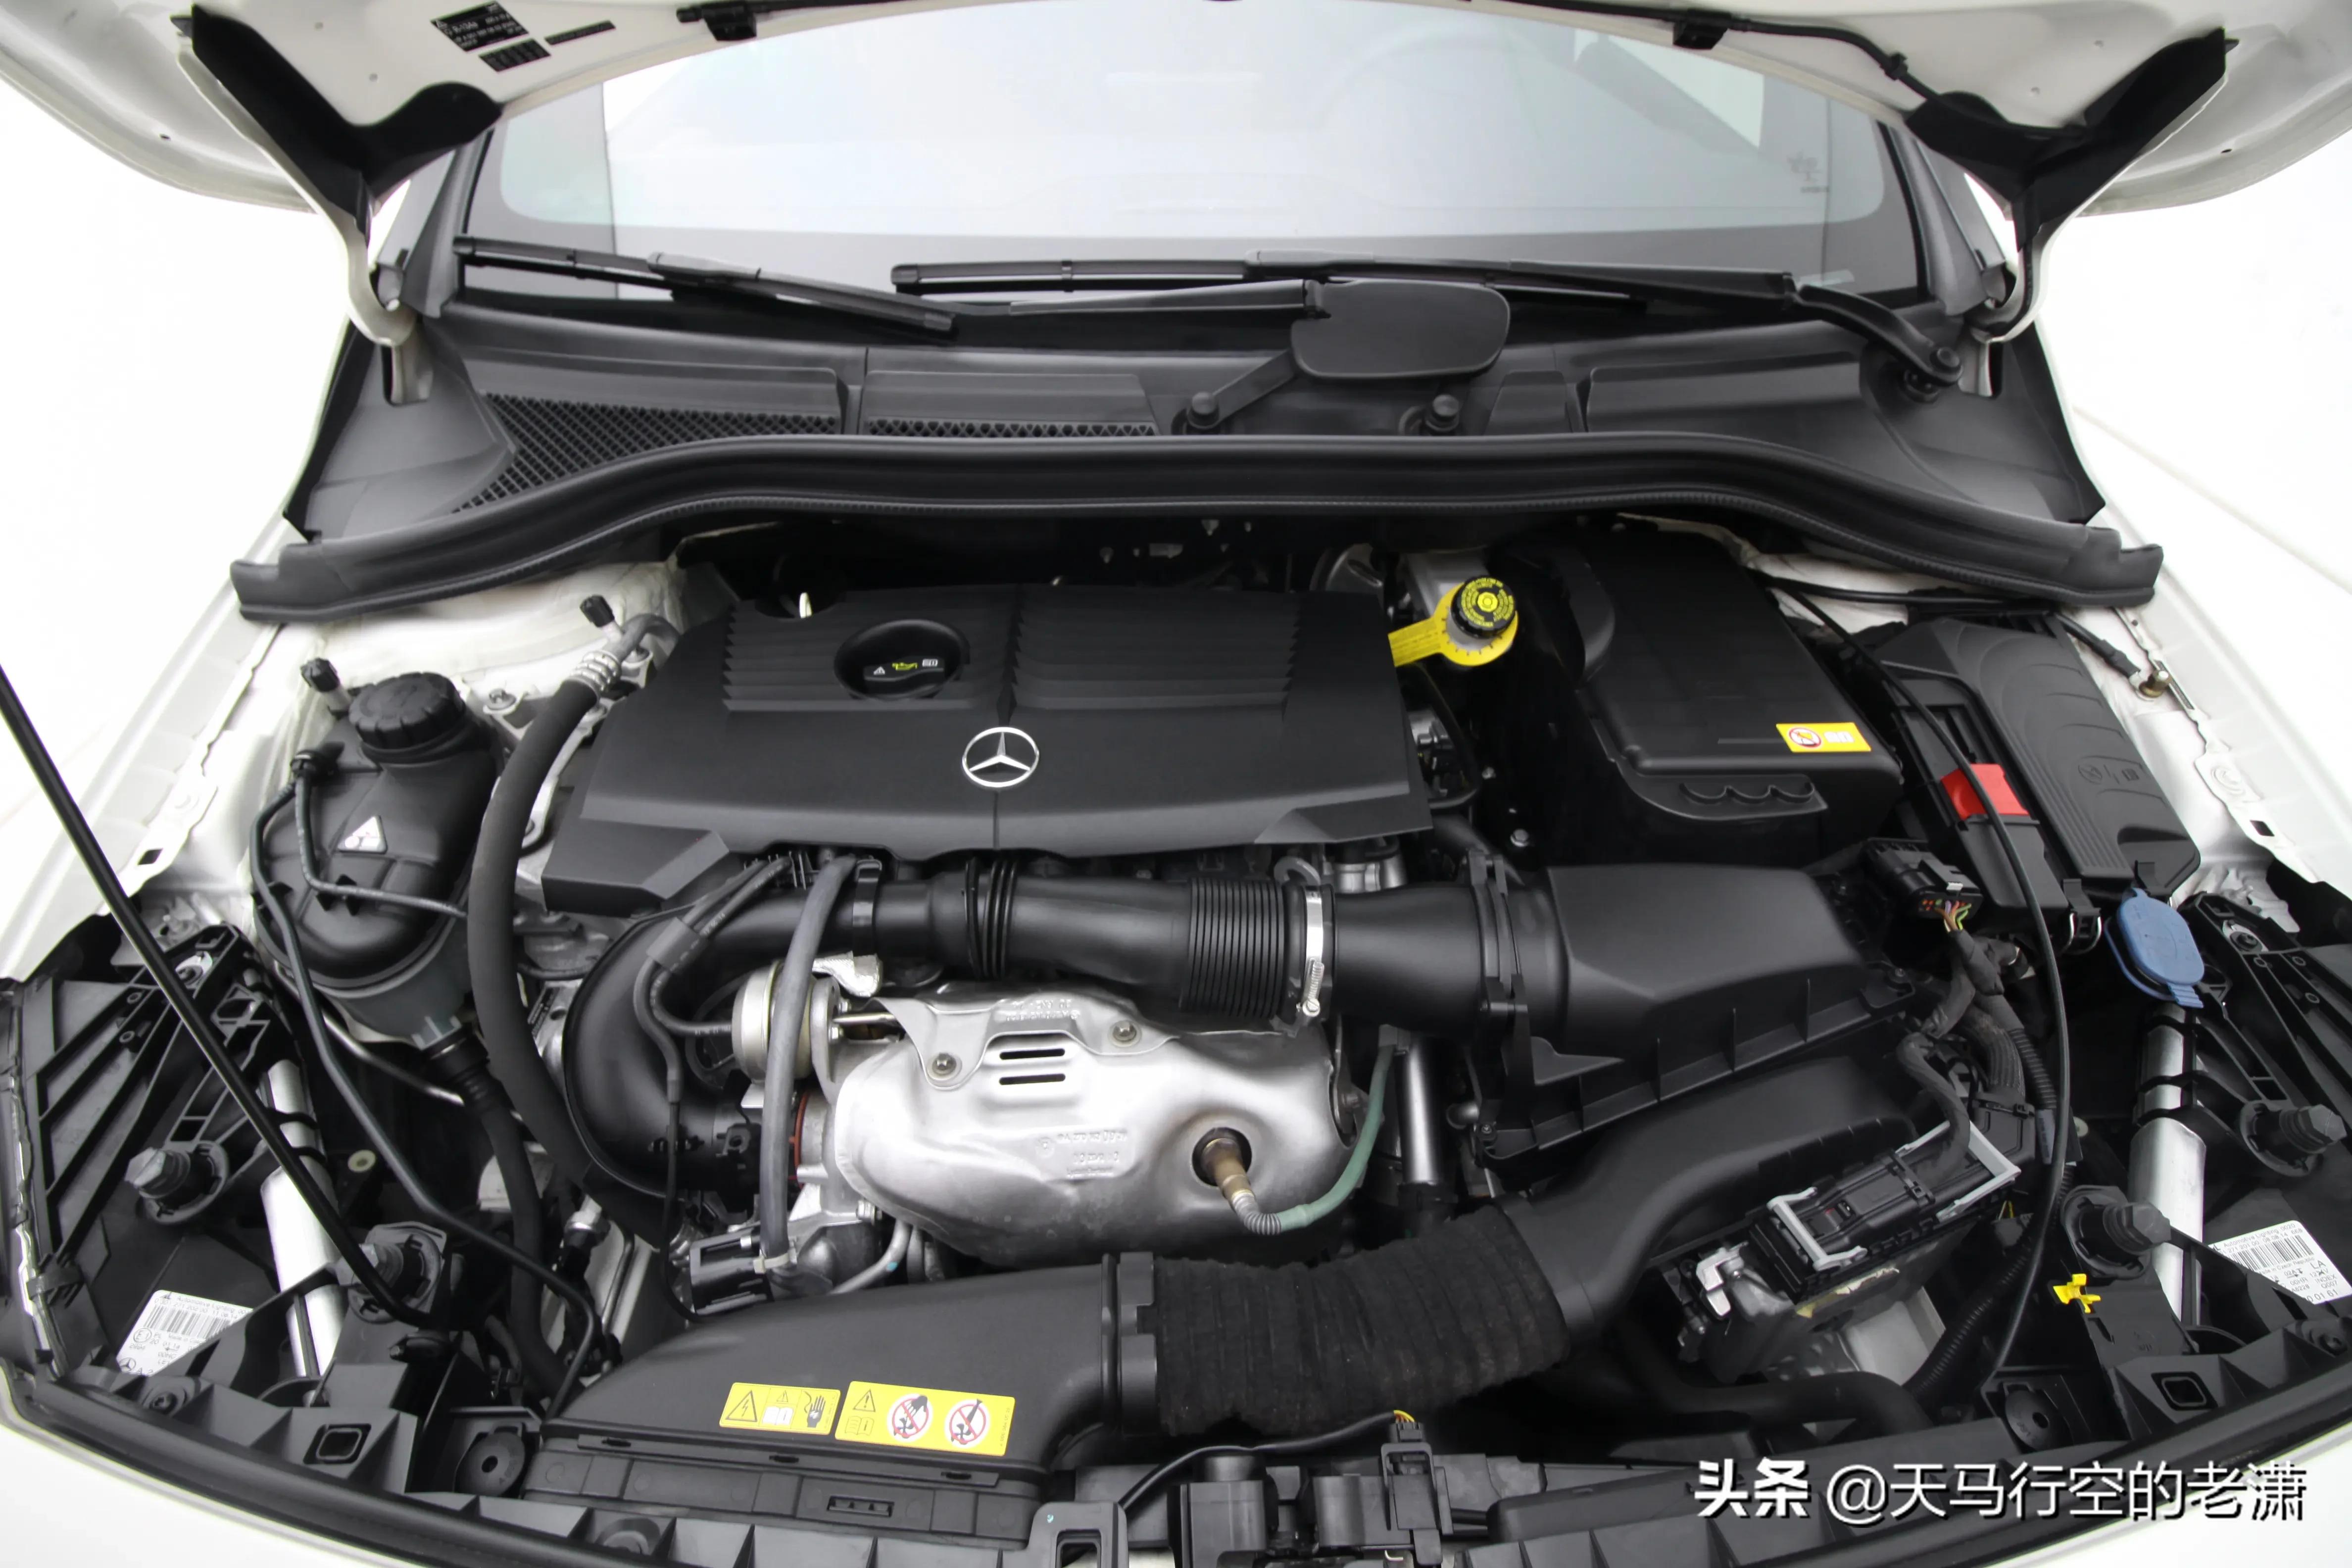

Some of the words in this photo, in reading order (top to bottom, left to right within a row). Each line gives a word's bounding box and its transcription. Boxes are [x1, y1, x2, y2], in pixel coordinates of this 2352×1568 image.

[2223, 1235, 2255, 1247] Automotive
[2255, 1229, 2279, 1238] Lighting
[2310, 1260, 2326, 1269] LA
[2315, 1274, 2337, 1283] INDEX
